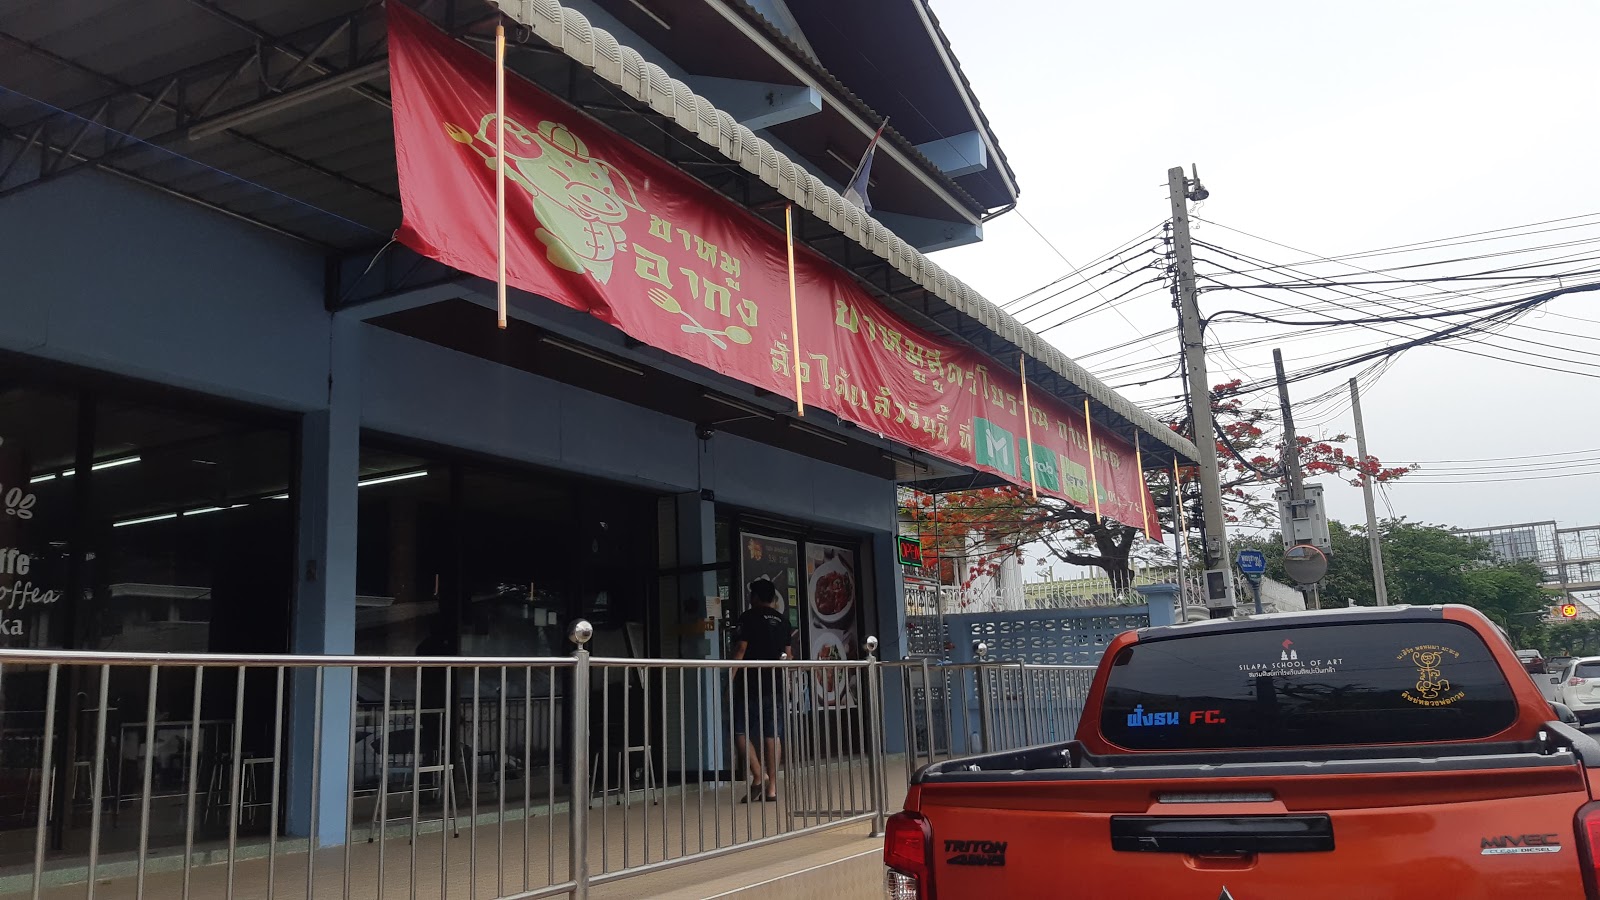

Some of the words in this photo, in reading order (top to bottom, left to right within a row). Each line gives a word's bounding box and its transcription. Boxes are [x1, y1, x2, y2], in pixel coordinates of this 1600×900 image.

[649, 214, 740, 291] ขาหมู
[632, 242, 758, 326] อากง
[901, 542, 920, 560] OPEN
[1239, 663, 1268, 671] SILAPA
[1272, 660, 1305, 669] SCHOOL
[1310, 659, 1321, 667] OF
[1189, 709, 1227, 724] FC.
[944, 840, 1008, 854] TRITON
[1480, 833, 1560, 848] MIVEC
